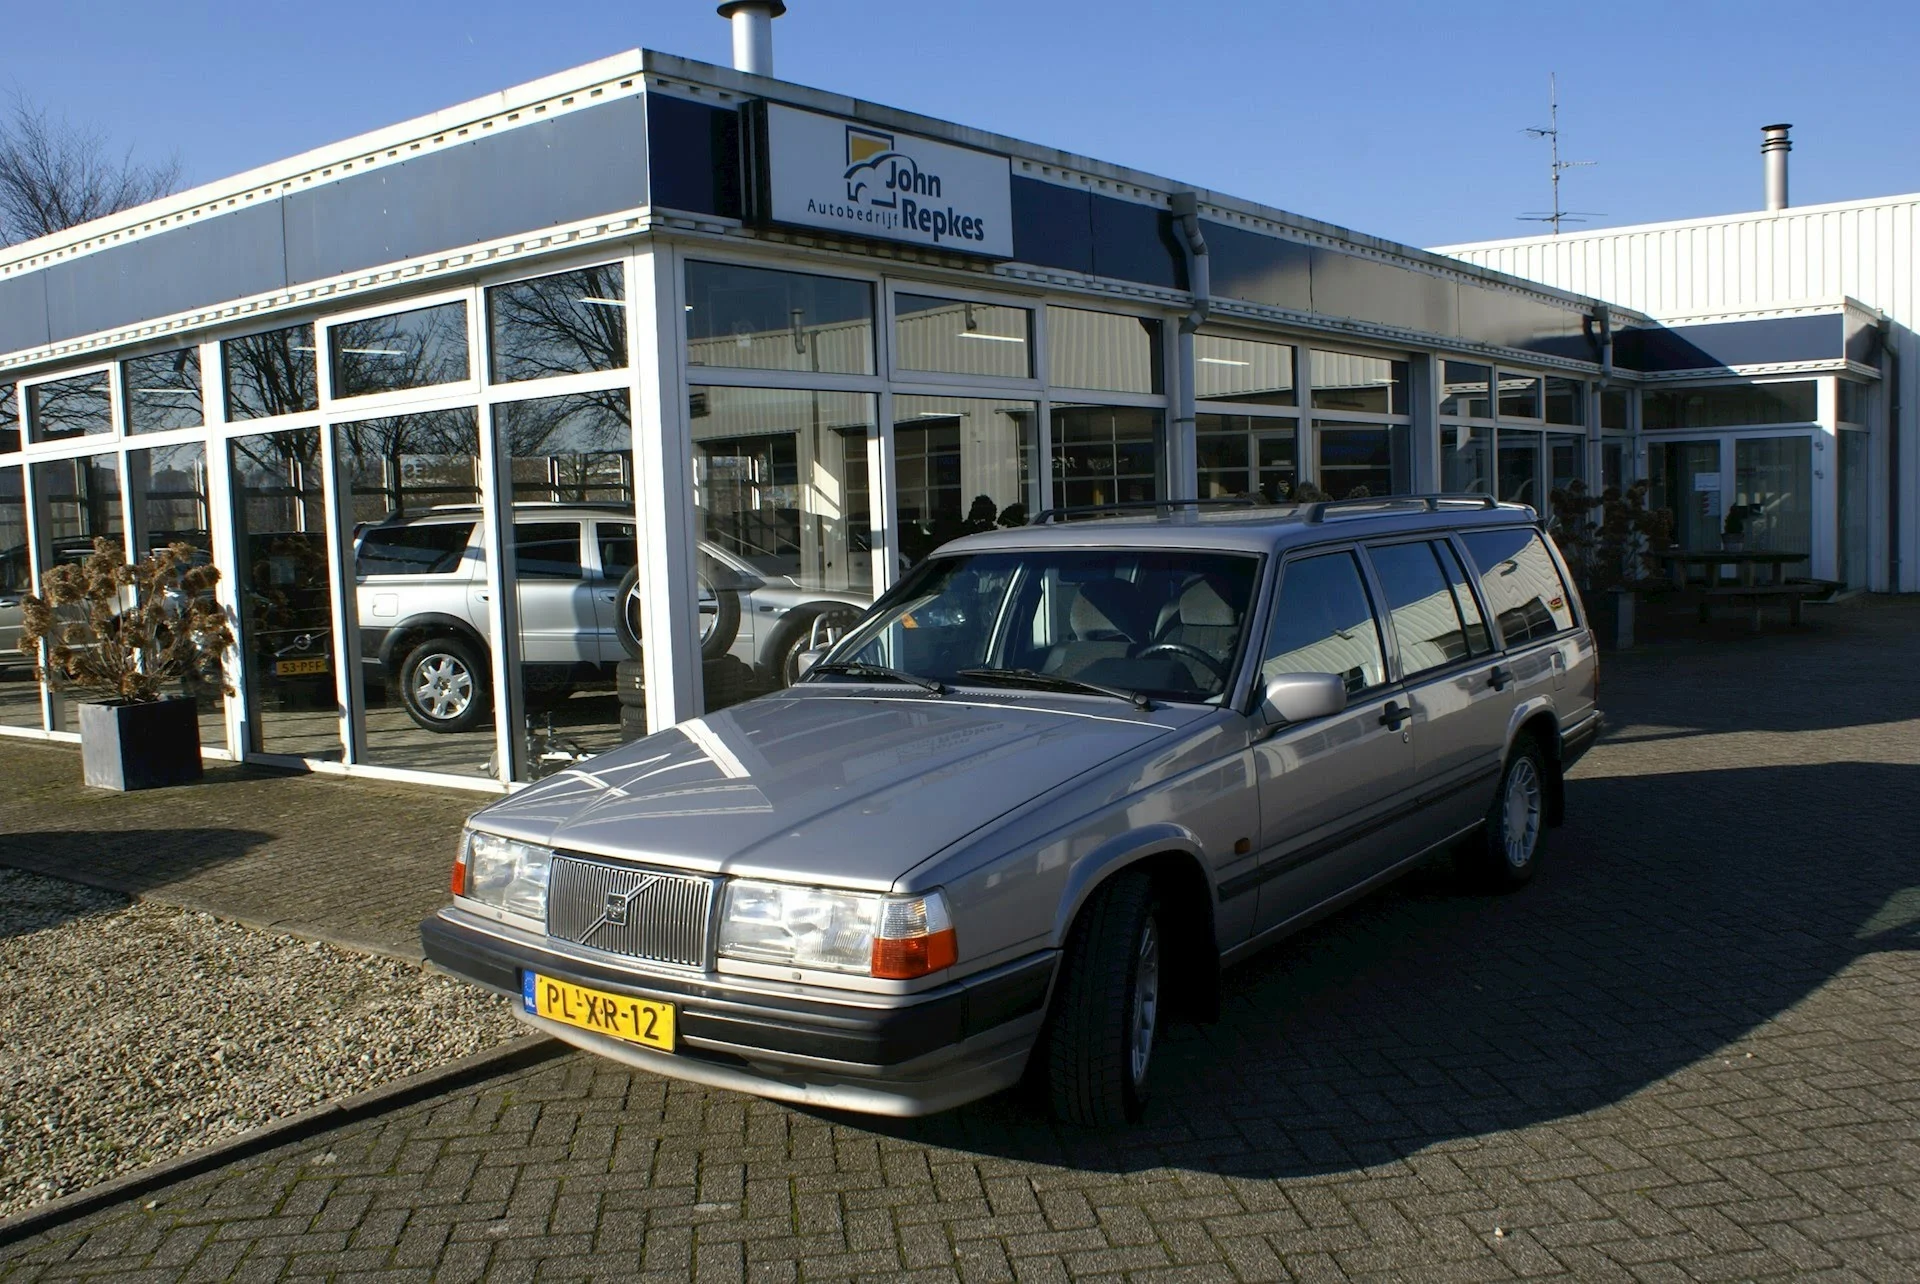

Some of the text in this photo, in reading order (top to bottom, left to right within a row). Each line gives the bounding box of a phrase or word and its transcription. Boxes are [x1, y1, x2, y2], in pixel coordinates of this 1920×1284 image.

[886, 160, 941, 198] John
[807, 198, 985, 243] Autobedrijf Repkes
[525, 983, 659, 1041] NL PL-XR-12
